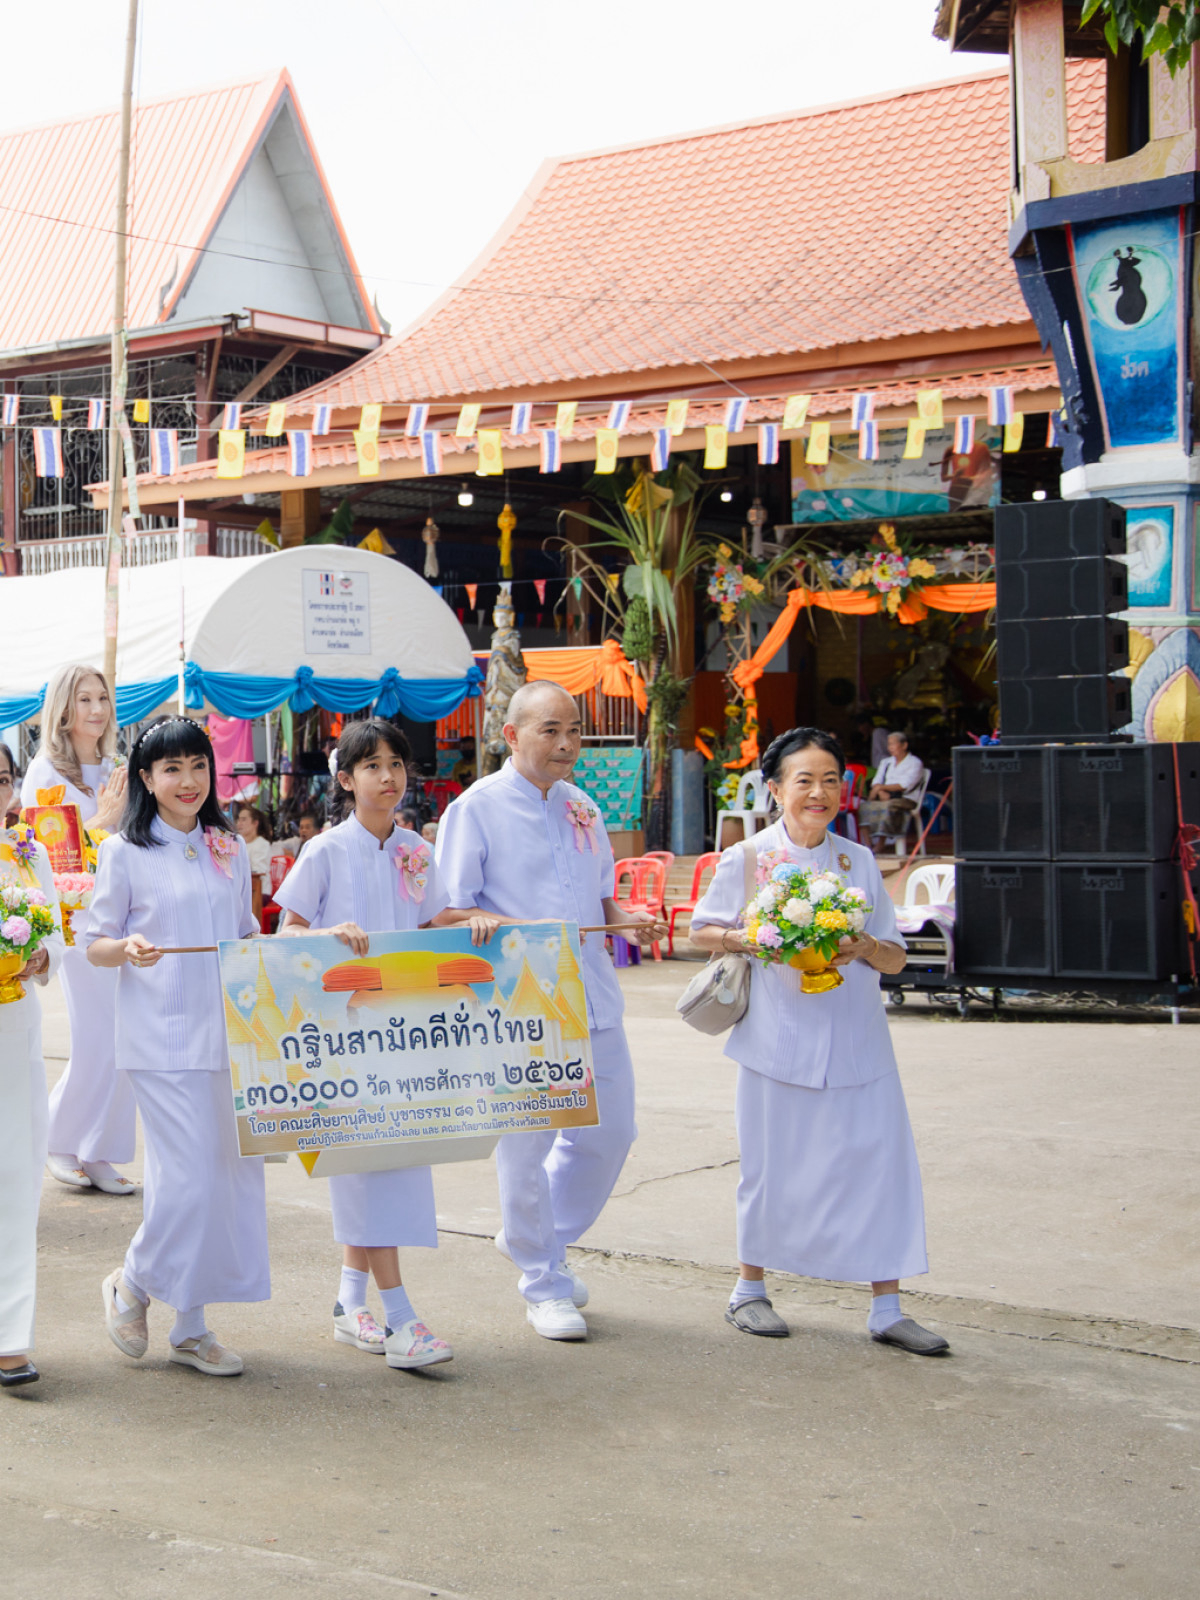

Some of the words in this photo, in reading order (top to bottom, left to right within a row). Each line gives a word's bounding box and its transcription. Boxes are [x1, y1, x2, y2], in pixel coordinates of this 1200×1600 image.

[281, 1002, 544, 1069] กฐินสามัคคีทั่วไทย
[247, 1078, 359, 1109] ๓๐,๐๐๐
[367, 1073, 391, 1096] วัด
[396, 1068, 497, 1102] พุทธศักราช
[502, 1057, 584, 1087] ๒๕๖๘
[249, 1116, 277, 1134] โดย
[280, 1105, 387, 1131] คณะศิษยานุศิษย์
[390, 1104, 451, 1127] บูชาธรรม
[455, 1106, 474, 1118] ๘๑
[477, 1098, 488, 1115] ปี
[491, 1091, 587, 1114] หลวงพ่อธัมมชโย
[298, 1126, 421, 1150] ศูนย์ปฏิบัติธรรมแก้วเมืองเลย
[422, 1125, 440, 1135] และ
